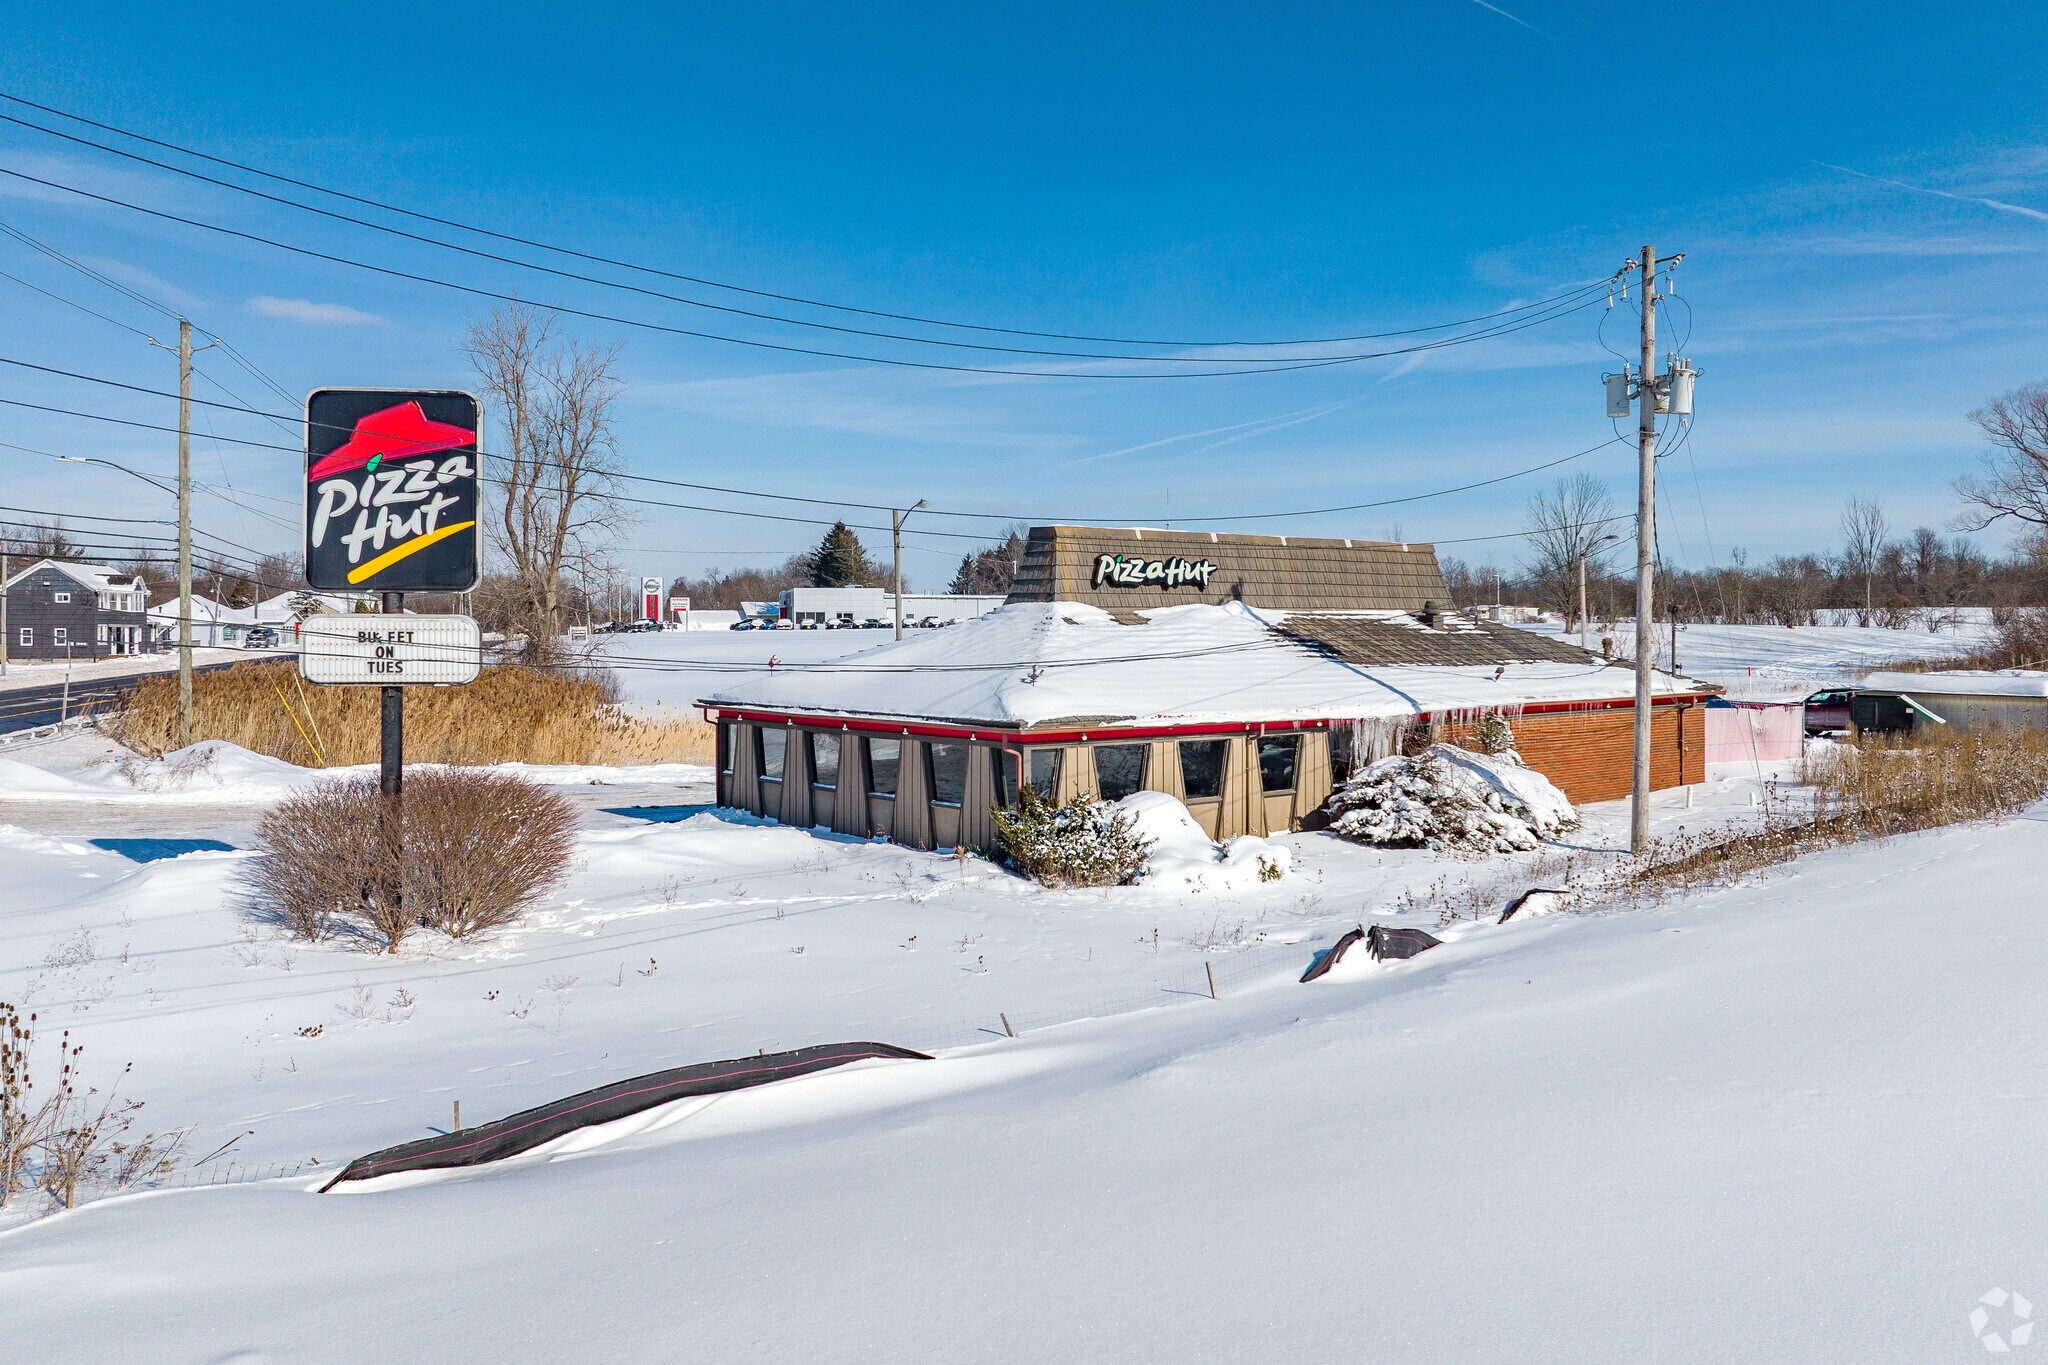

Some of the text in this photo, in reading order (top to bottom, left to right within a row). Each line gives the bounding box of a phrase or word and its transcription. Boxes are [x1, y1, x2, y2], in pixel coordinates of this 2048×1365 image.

[311, 453, 475, 548] Pizza
[341, 492, 461, 564] Hut
[1097, 554, 1218, 587] Pizza Hut
[367, 661, 403, 673] TUES
[376, 646, 394, 658] ON
